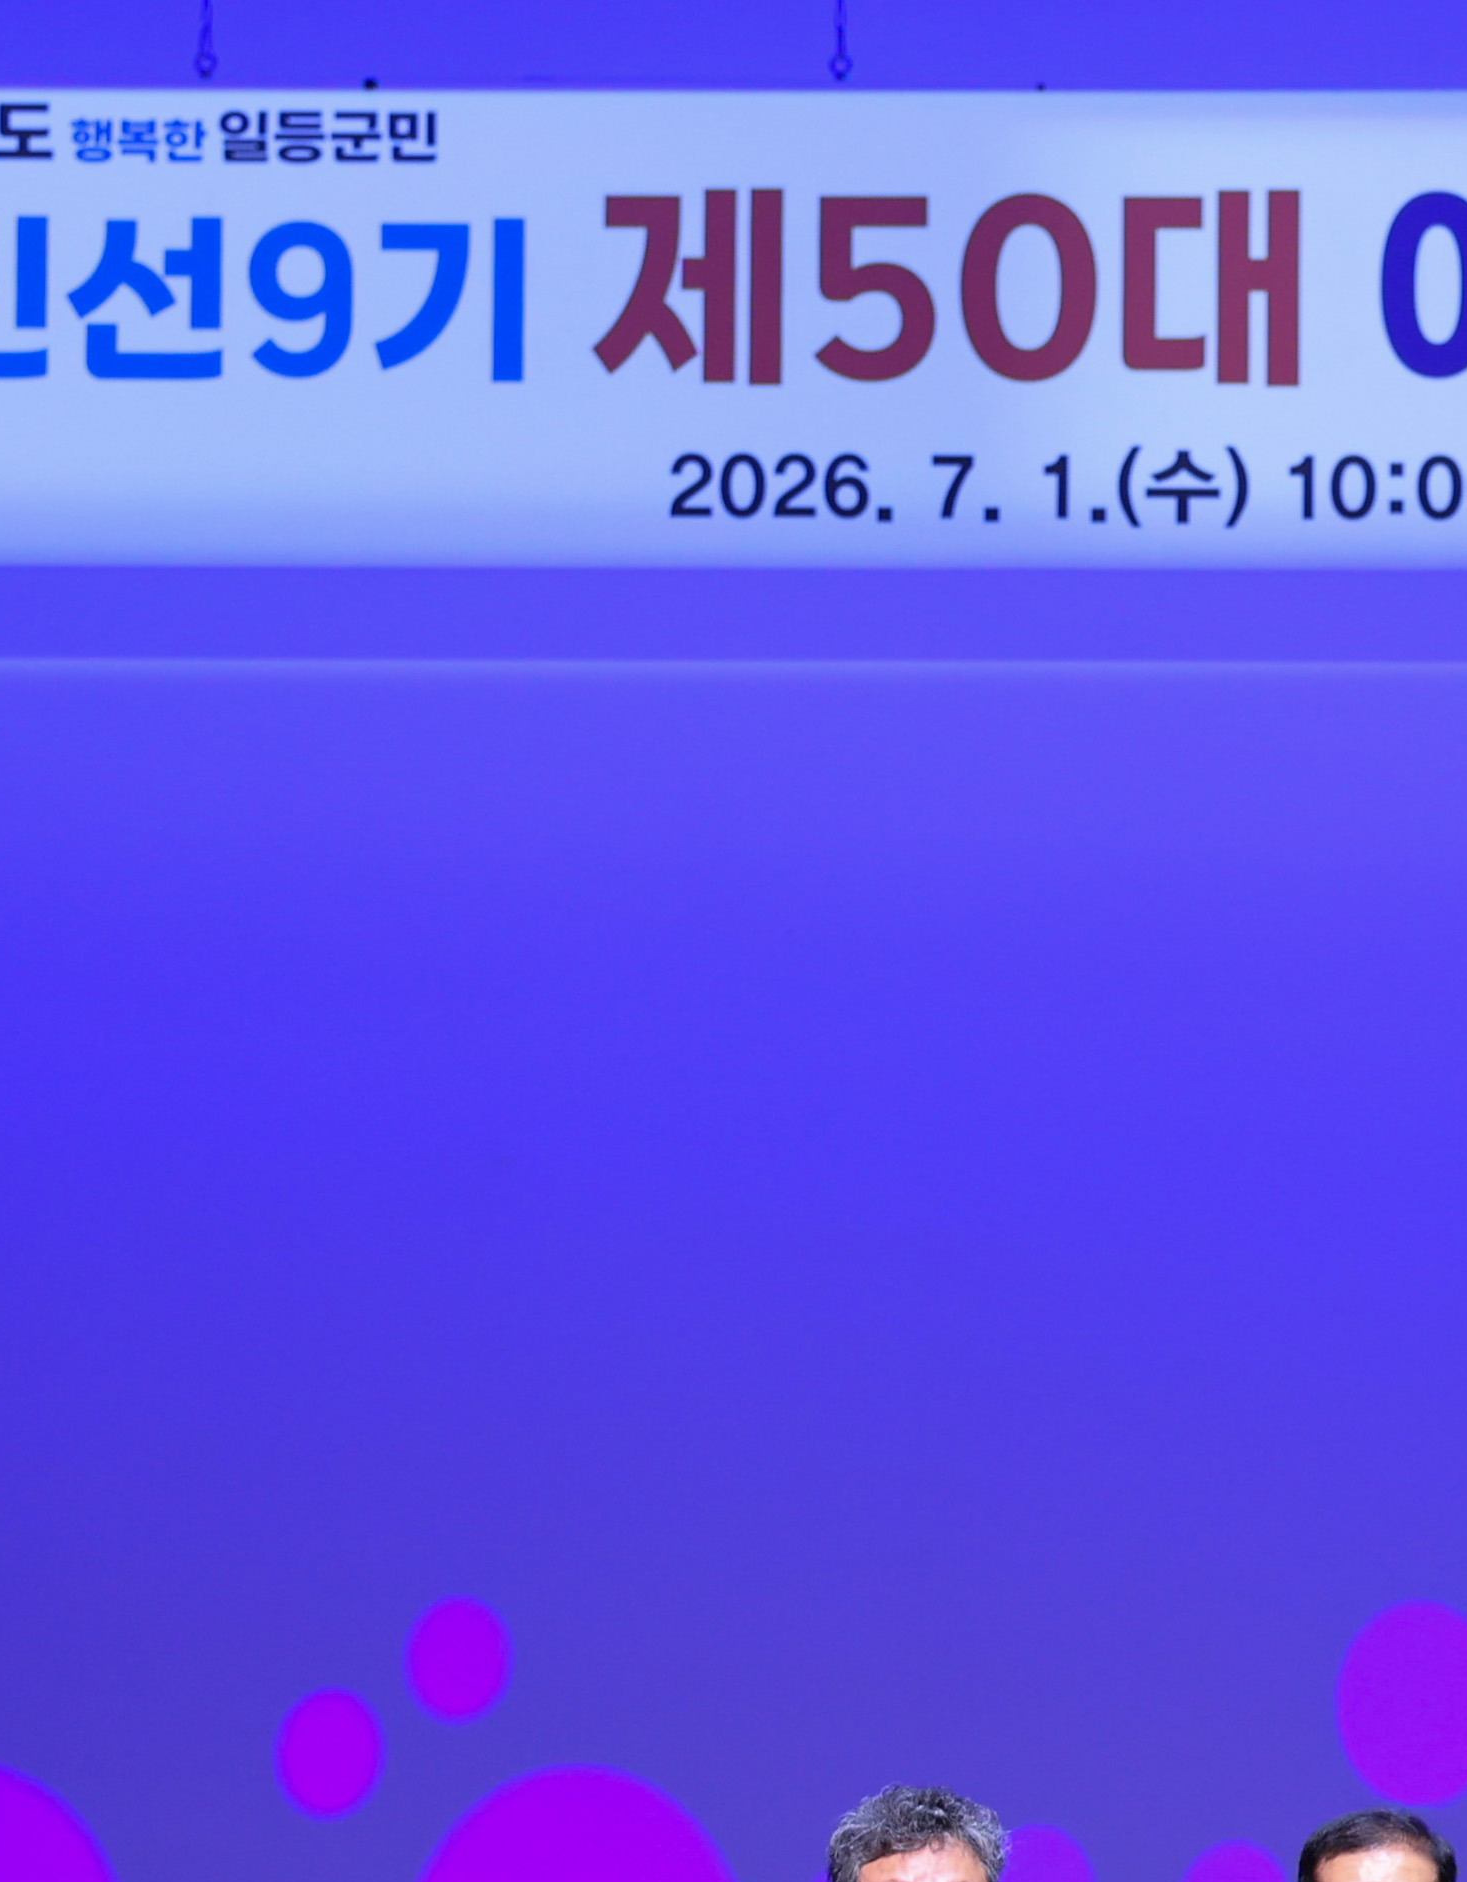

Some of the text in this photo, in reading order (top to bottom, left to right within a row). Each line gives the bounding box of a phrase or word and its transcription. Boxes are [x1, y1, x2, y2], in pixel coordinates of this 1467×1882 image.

[70, 118, 208, 163] 행복한
[219, 110, 438, 163] 일등군민
[591, 188, 1301, 387] 제50대
[669, 453, 894, 523] 2026.
[932, 453, 1001, 523] 7.
